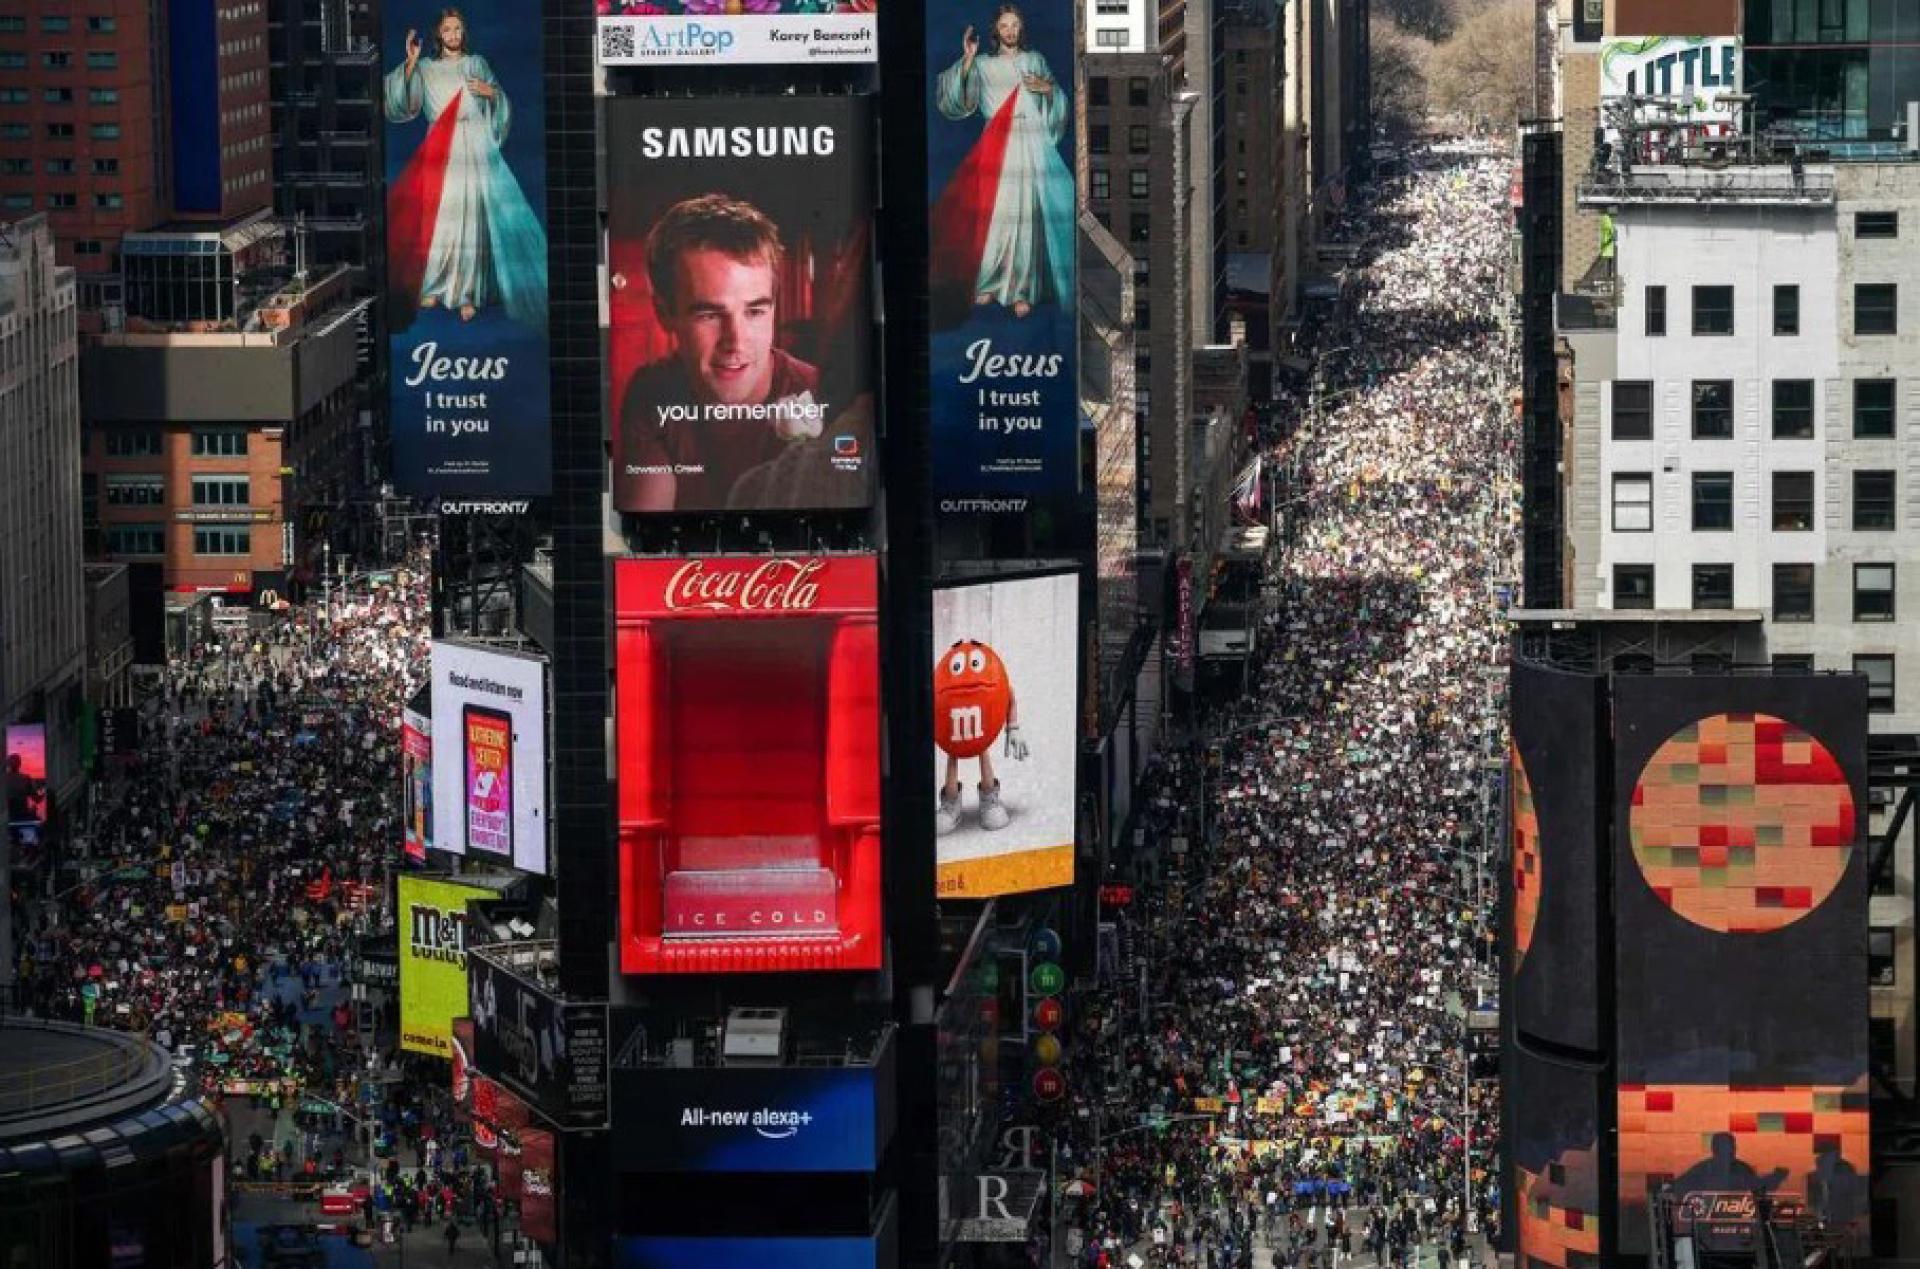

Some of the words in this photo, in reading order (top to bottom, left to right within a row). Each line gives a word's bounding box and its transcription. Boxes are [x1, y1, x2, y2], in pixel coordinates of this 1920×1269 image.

[641, 23, 733, 53] ArtPop
[643, 126, 834, 158] SAMSUNG
[405, 342, 509, 386] Jesus
[959, 338, 1063, 384] Jesus
[425, 391, 432, 408] I
[437, 392, 488, 409] trust
[978, 389, 984, 406] I
[990, 390, 1041, 406] trust
[426, 415, 446, 433] in
[451, 418, 490, 437] you
[657, 404, 698, 428] you
[704, 401, 829, 420] remember
[978, 412, 999, 430] in
[1004, 416, 1042, 434] you
[665, 559, 827, 609] Coca-Cola
[678, 912, 727, 926] ICE
[751, 911, 826, 925] COLD
[680, 1107, 749, 1126] All-new
[753, 1107, 813, 1126] alexa+
[975, 1175, 1013, 1220] R
